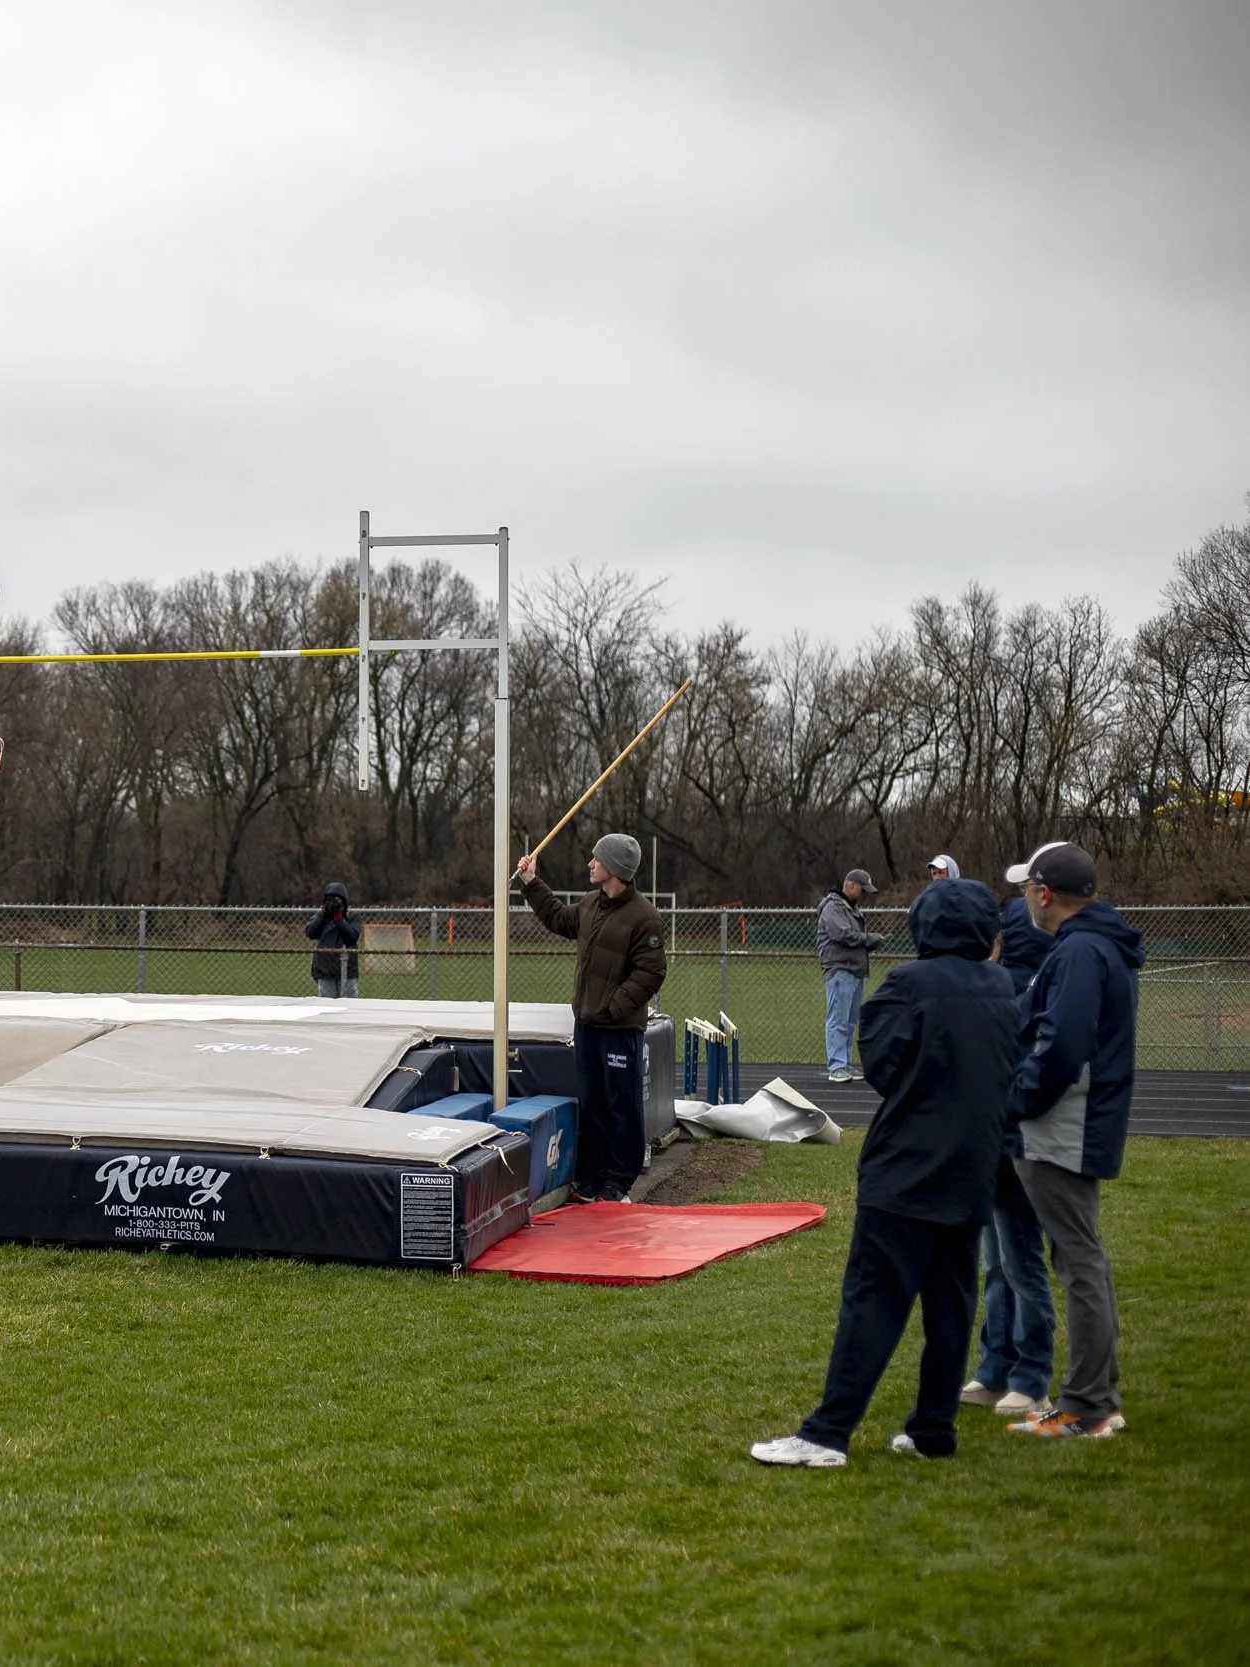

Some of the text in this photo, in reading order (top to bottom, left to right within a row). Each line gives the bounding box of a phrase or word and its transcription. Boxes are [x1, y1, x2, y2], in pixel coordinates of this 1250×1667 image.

[95, 1155, 231, 1206] Richey
[412, 1177, 450, 1185] WARNING
[104, 1205, 225, 1222] MICHIGANTOWN, IN
[128, 1219, 200, 1230] 1-800-333-PITS
[114, 1227, 215, 1242] RICHEYATHLETICS.COM
